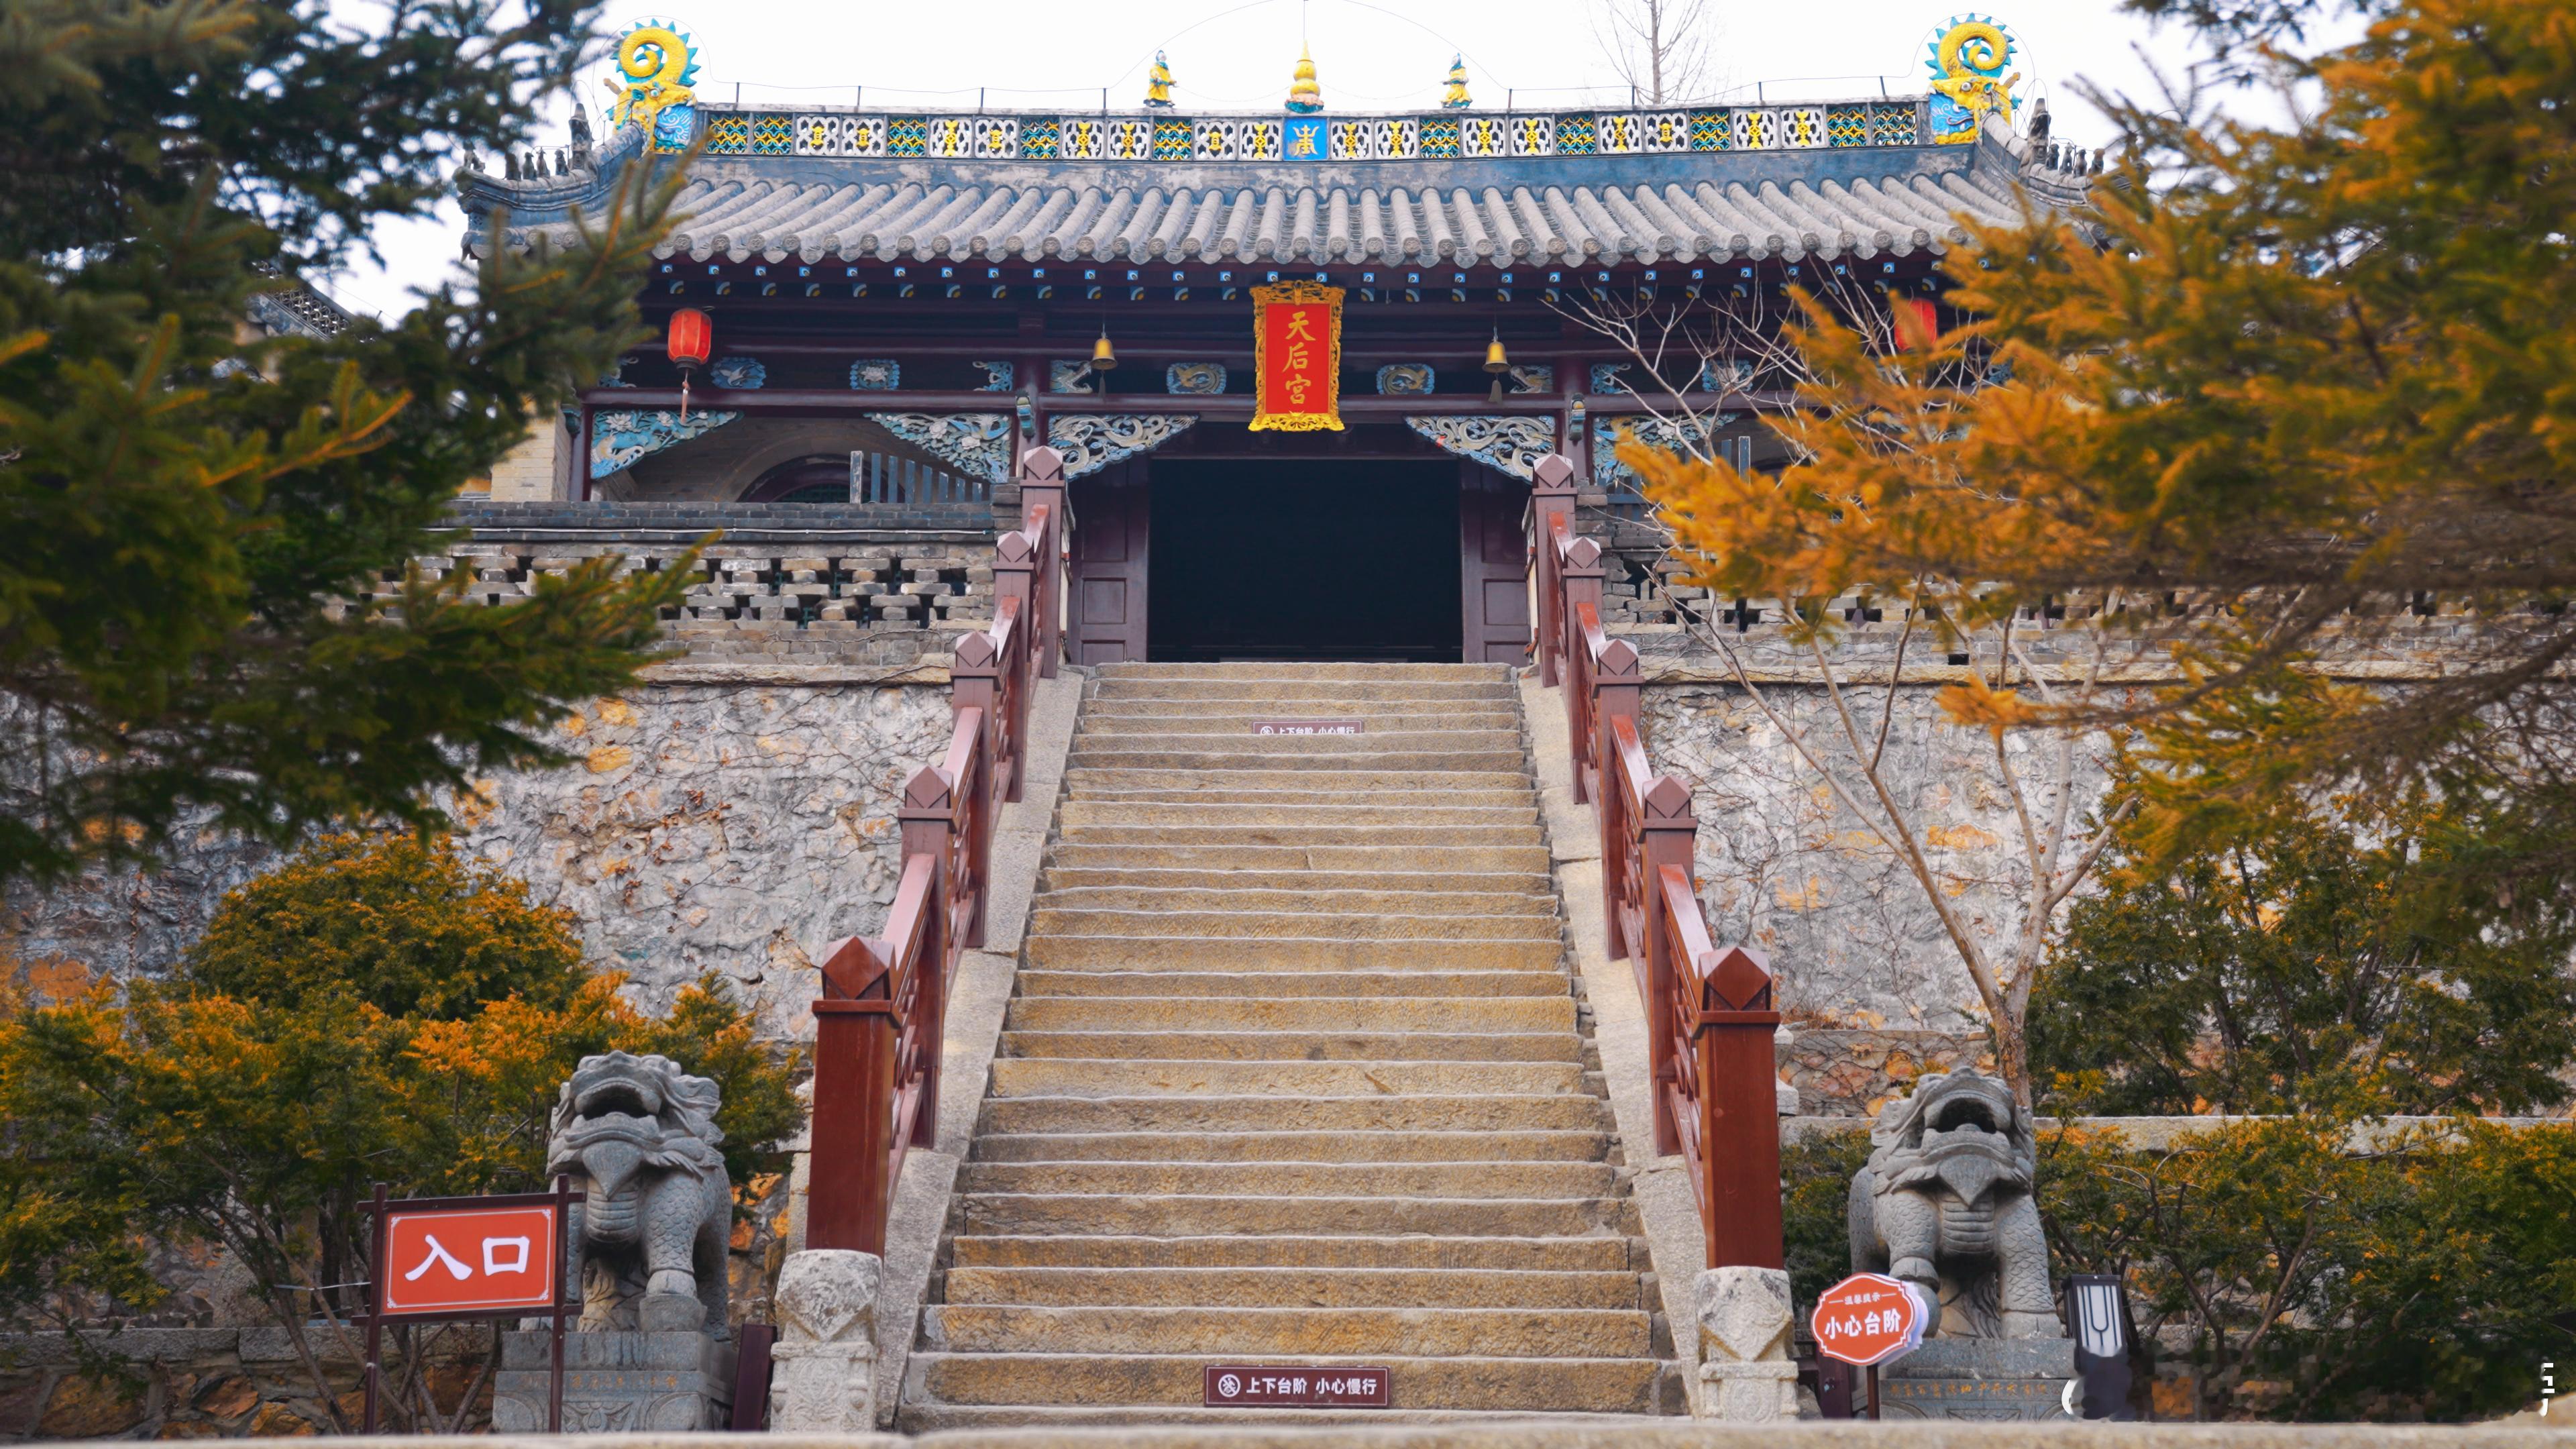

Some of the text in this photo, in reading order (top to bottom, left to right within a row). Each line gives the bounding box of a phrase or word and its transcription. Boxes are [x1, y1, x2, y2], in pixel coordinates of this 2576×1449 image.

[1283, 311, 1316, 405] 天后宫
[405, 1234, 530, 1281] 入口
[1844, 1292, 1881, 1305] 温馨提示
[1825, 1308, 1901, 1340] 小心台阶
[1246, 1377, 1377, 1395] 上下台阶 小心慢行
